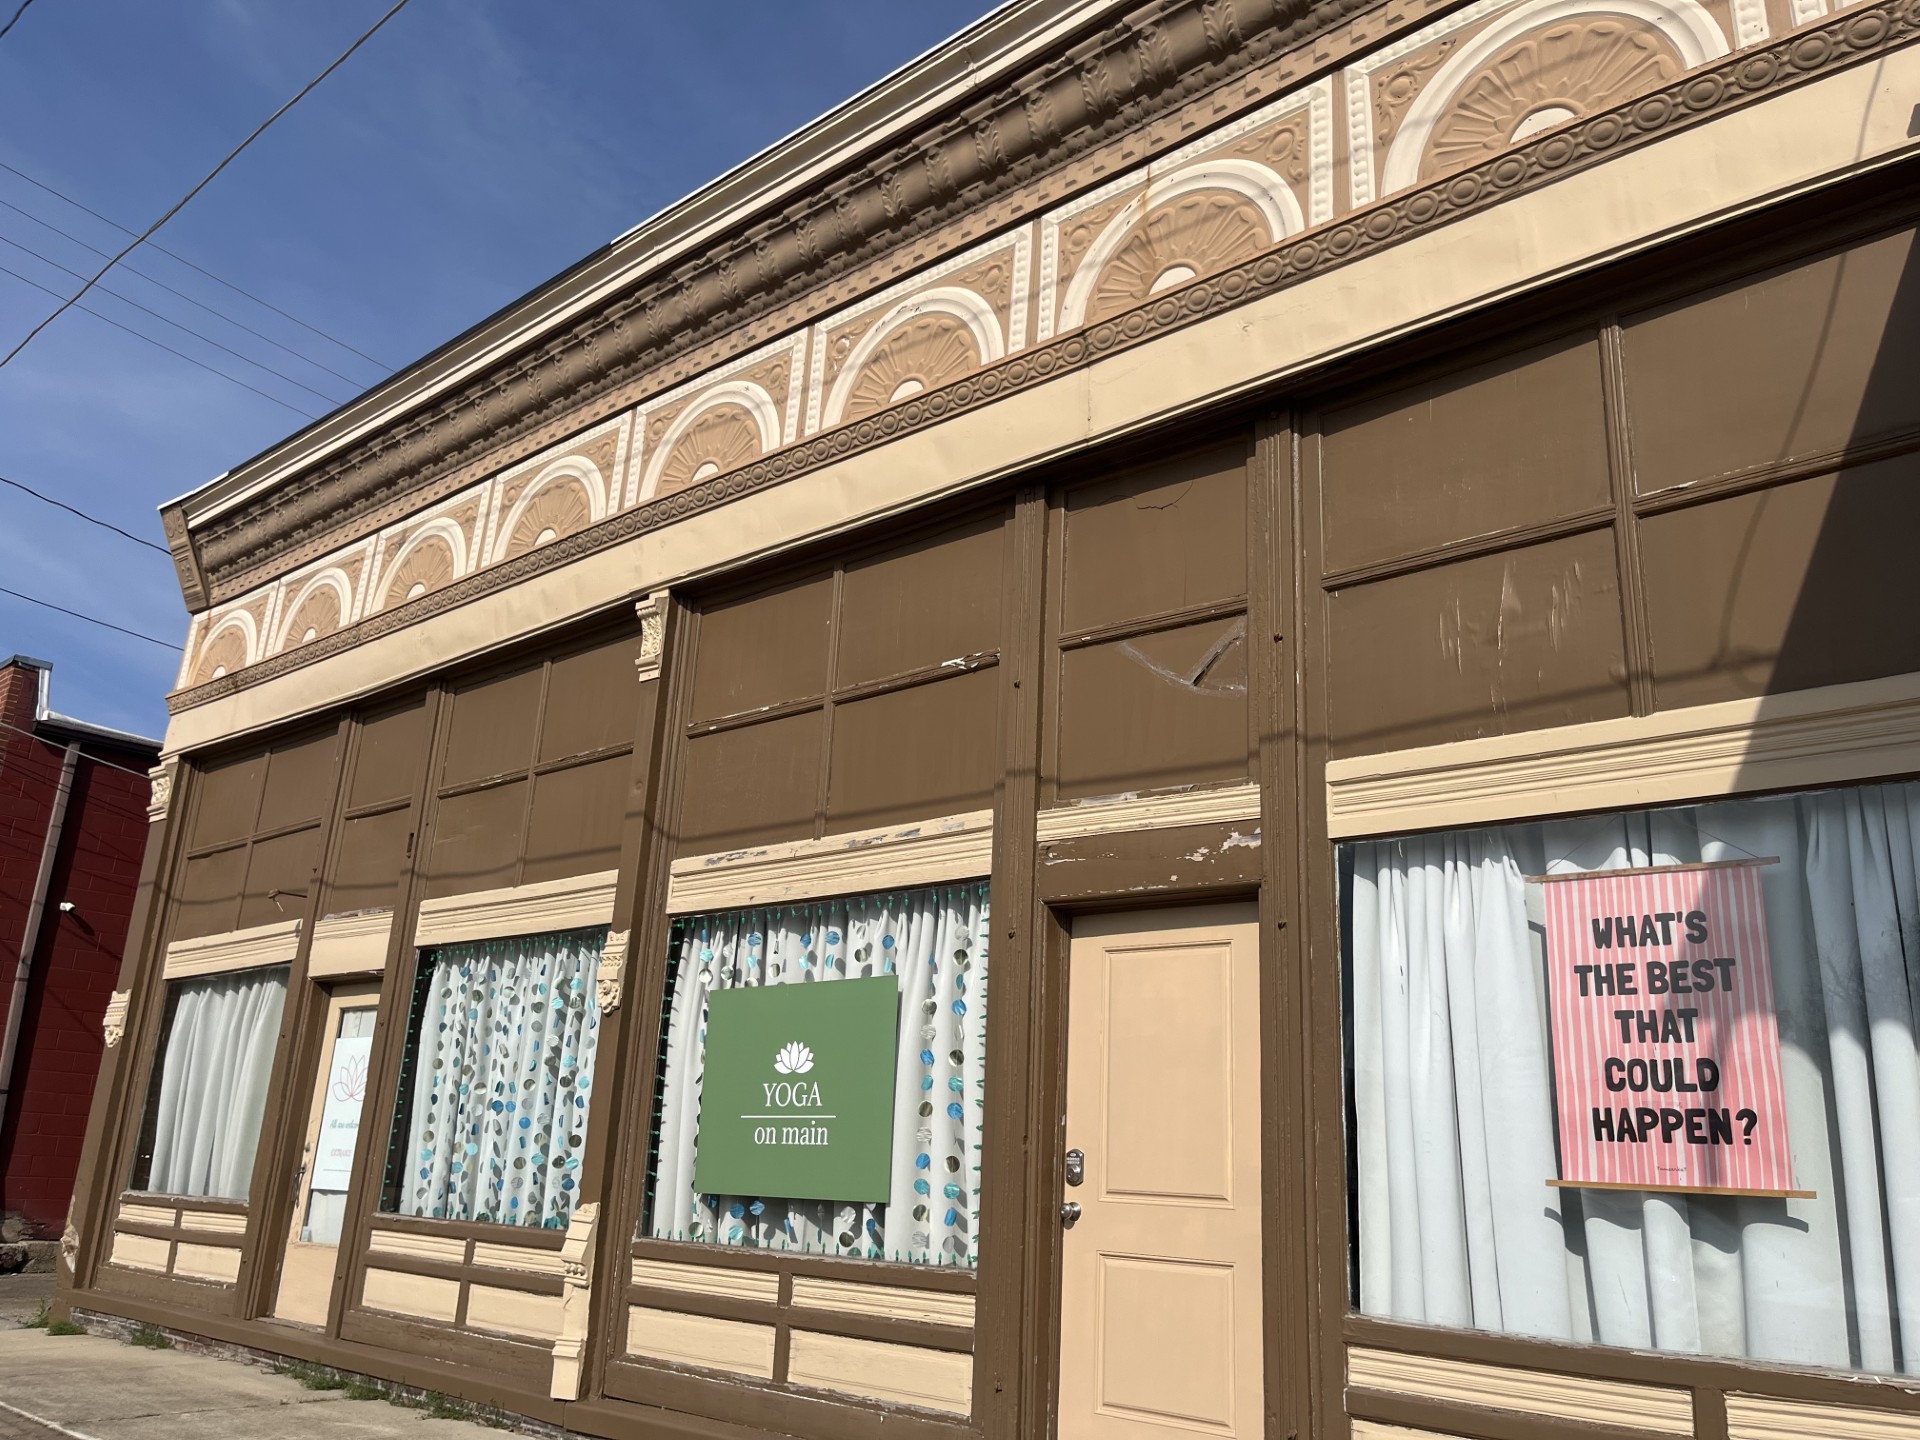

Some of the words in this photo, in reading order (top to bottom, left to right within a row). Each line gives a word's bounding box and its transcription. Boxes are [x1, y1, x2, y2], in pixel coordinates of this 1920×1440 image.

[1592, 910, 1708, 949] WHAT'S
[1573, 963, 1637, 997] THE
[1646, 958, 1736, 994] BEST
[1614, 1008, 1698, 1044] THAT
[1604, 1057, 1720, 1093] COULD
[763, 1081, 823, 1107] YOGA
[754, 1126, 777, 1145] on
[781, 1120, 829, 1146] main
[1592, 1107, 1758, 1145] HAPPEN?
